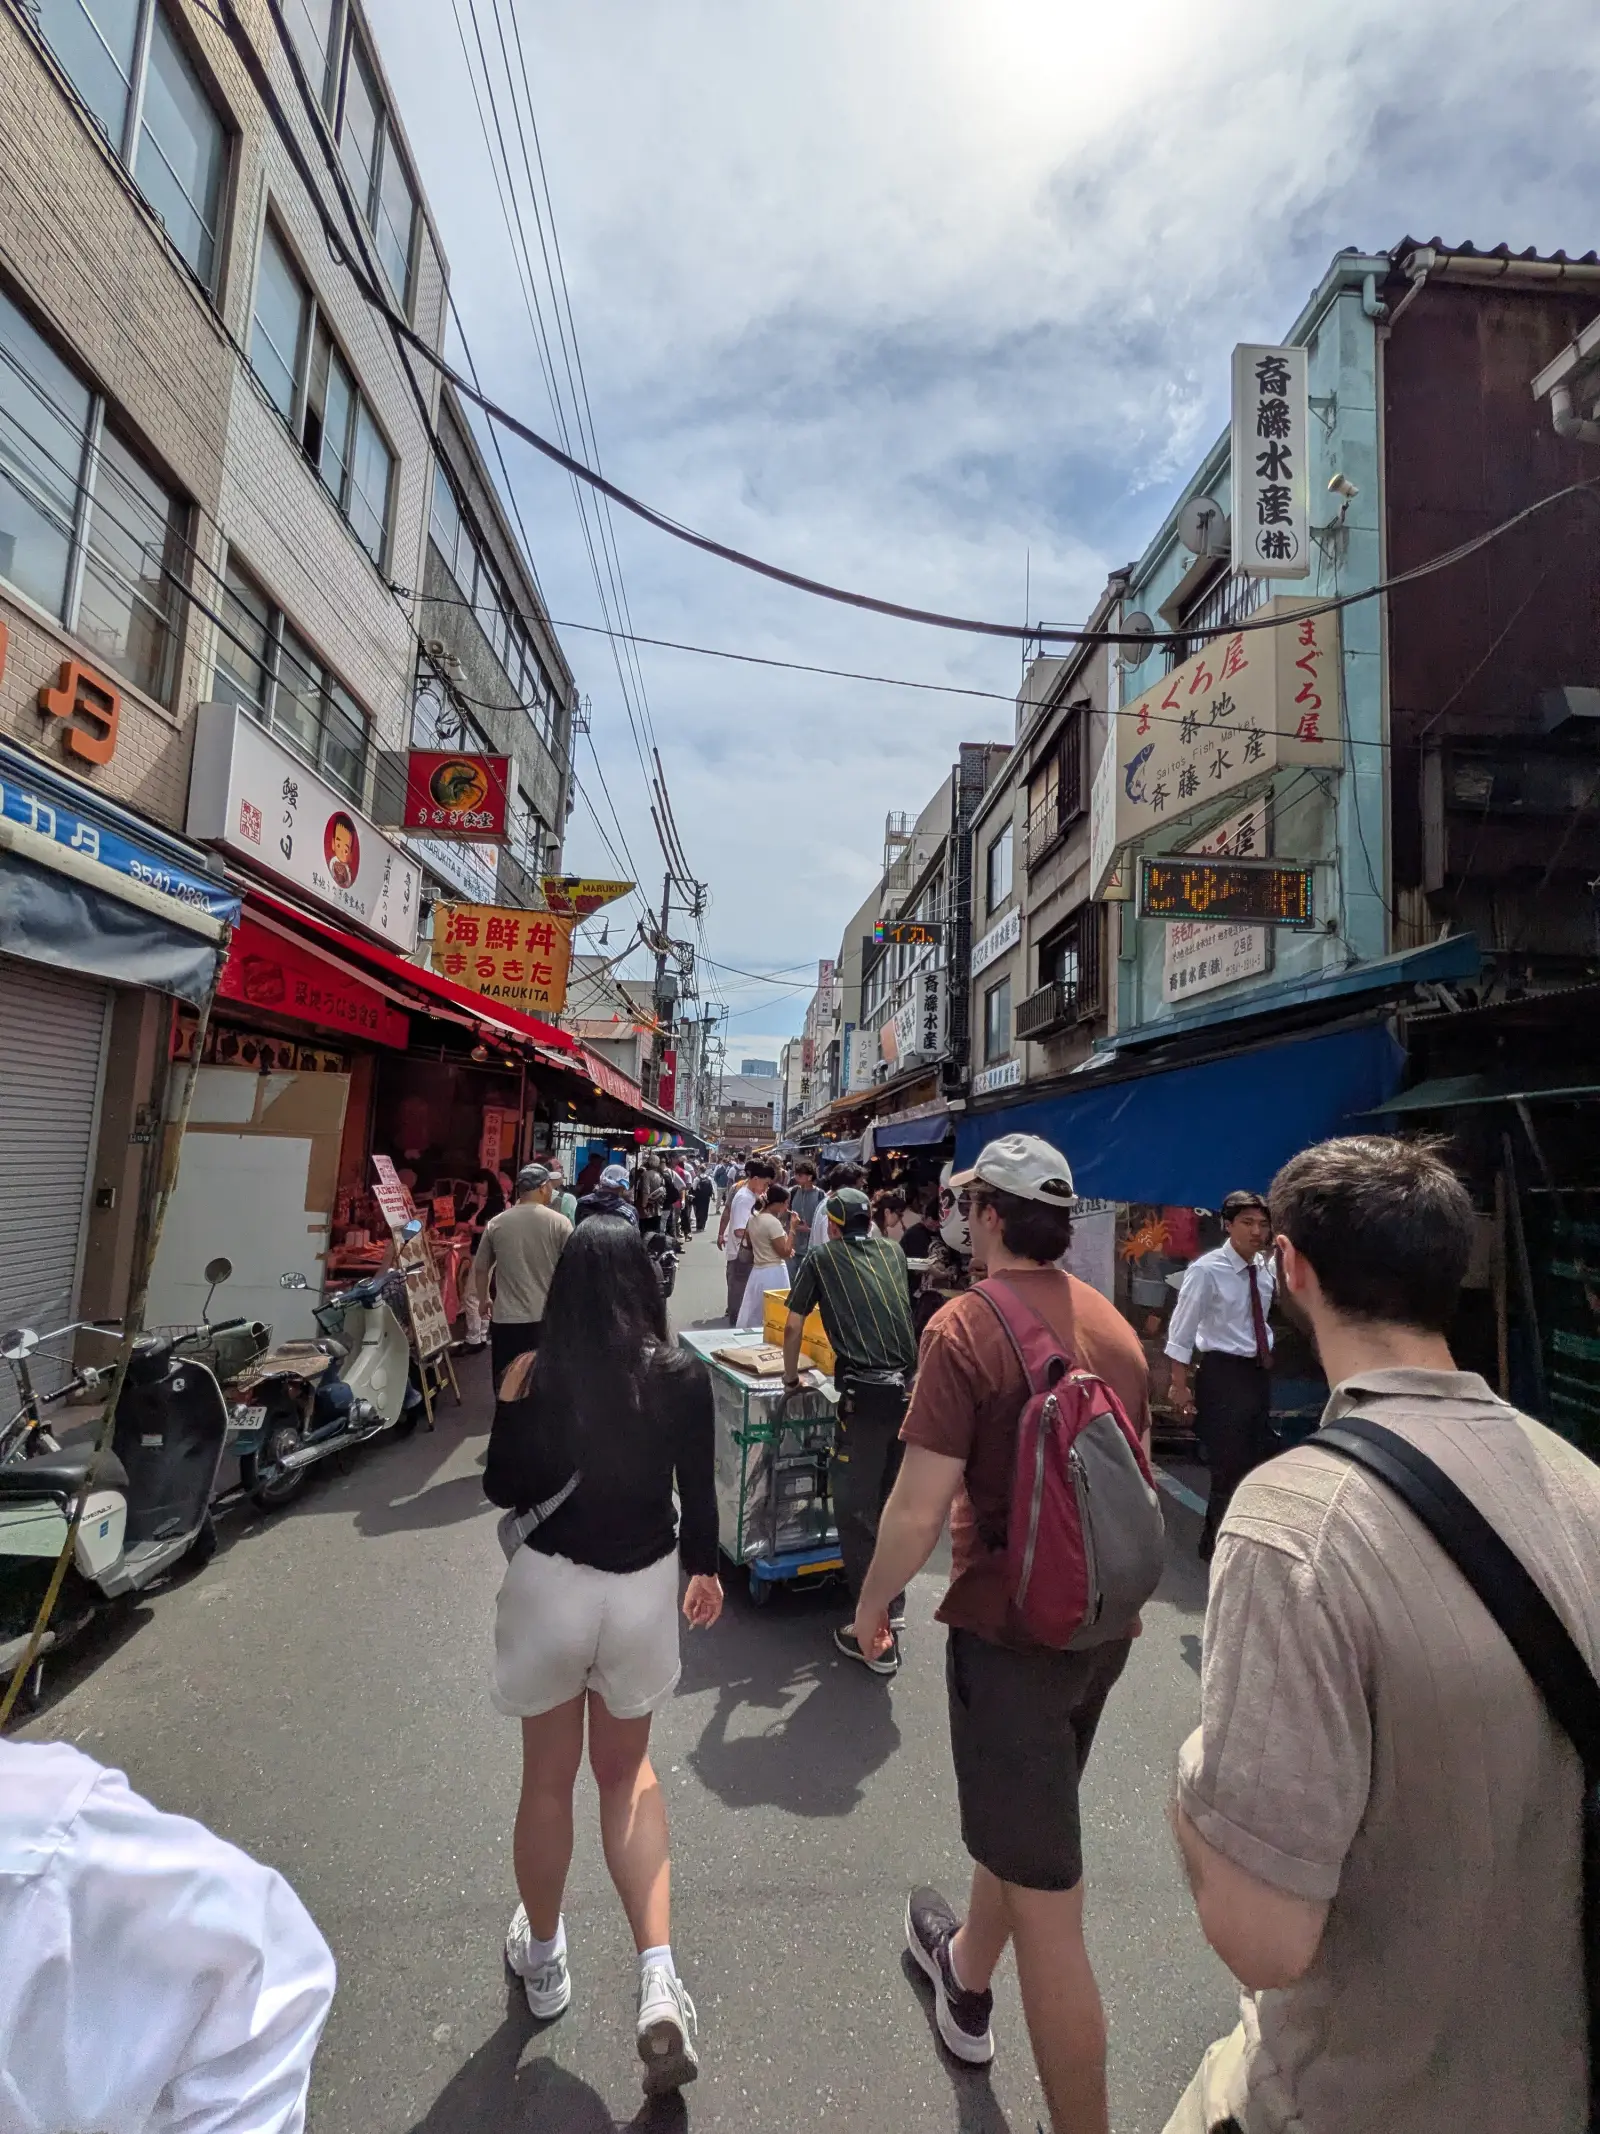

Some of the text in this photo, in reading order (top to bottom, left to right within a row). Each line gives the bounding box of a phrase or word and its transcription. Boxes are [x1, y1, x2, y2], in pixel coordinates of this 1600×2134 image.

[1136, 632, 1249, 736] まぐろ屋
[1294, 619, 1324, 743] まぐろ屋
[1180, 691, 1236, 745] 築地
[1192, 739, 1214, 760] Fish
[1221, 716, 1256, 743] Market
[418, 808, 495, 829] うなぎ食堂
[582, 884, 628, 893] MARUKITA
[445, 912, 556, 957] 海鮮丼
[1233, 934, 1253, 956] 2号店
[444, 954, 552, 986] まるきた
[480, 983, 549, 1003] MARUKITA
